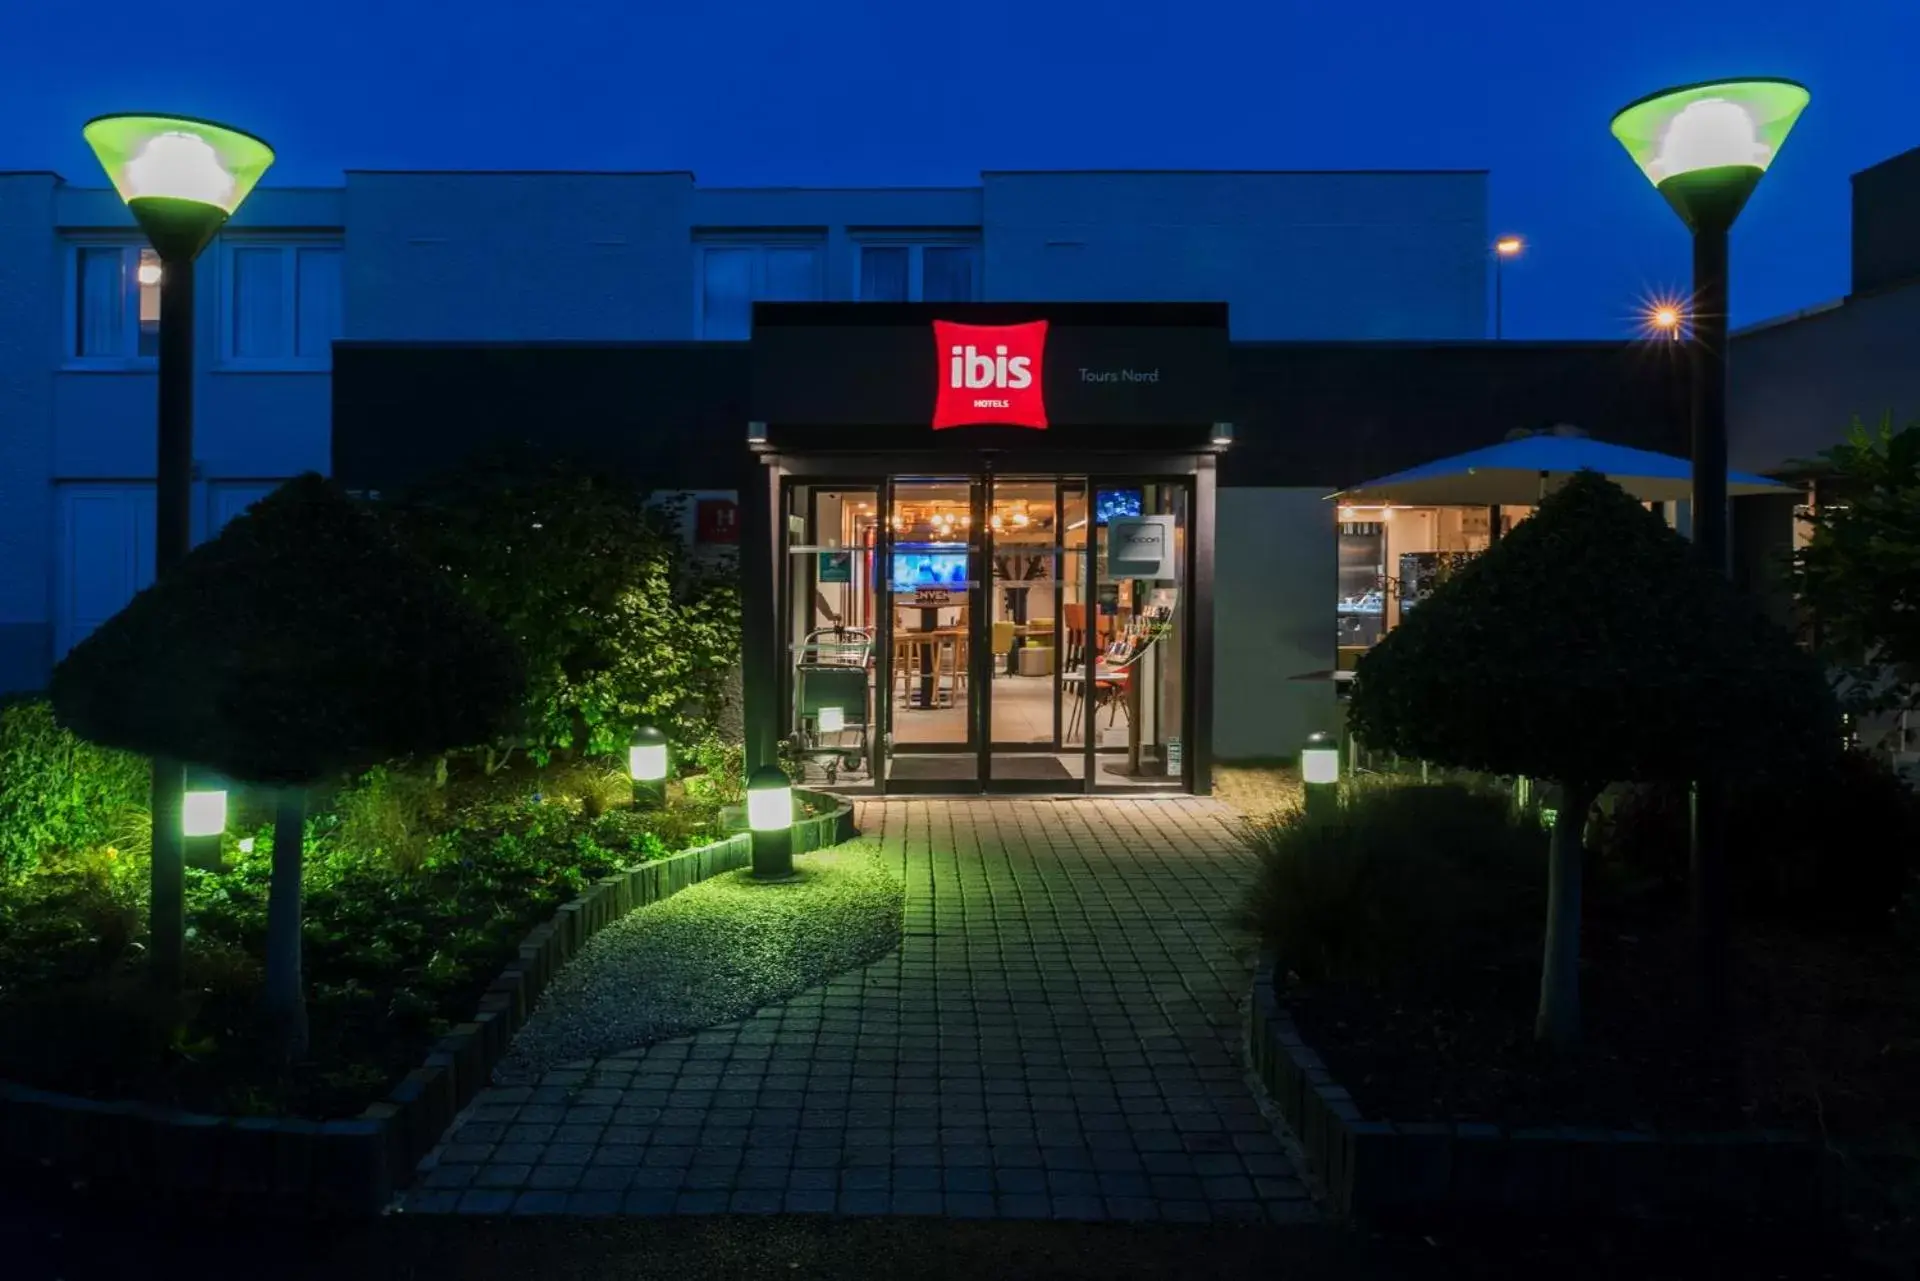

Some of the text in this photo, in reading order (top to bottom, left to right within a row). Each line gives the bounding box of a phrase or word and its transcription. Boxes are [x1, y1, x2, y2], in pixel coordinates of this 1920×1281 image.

[951, 345, 1032, 389] ibis
[1078, 368, 1160, 382] Tours Nord
[973, 400, 1010, 408] HOTELS
